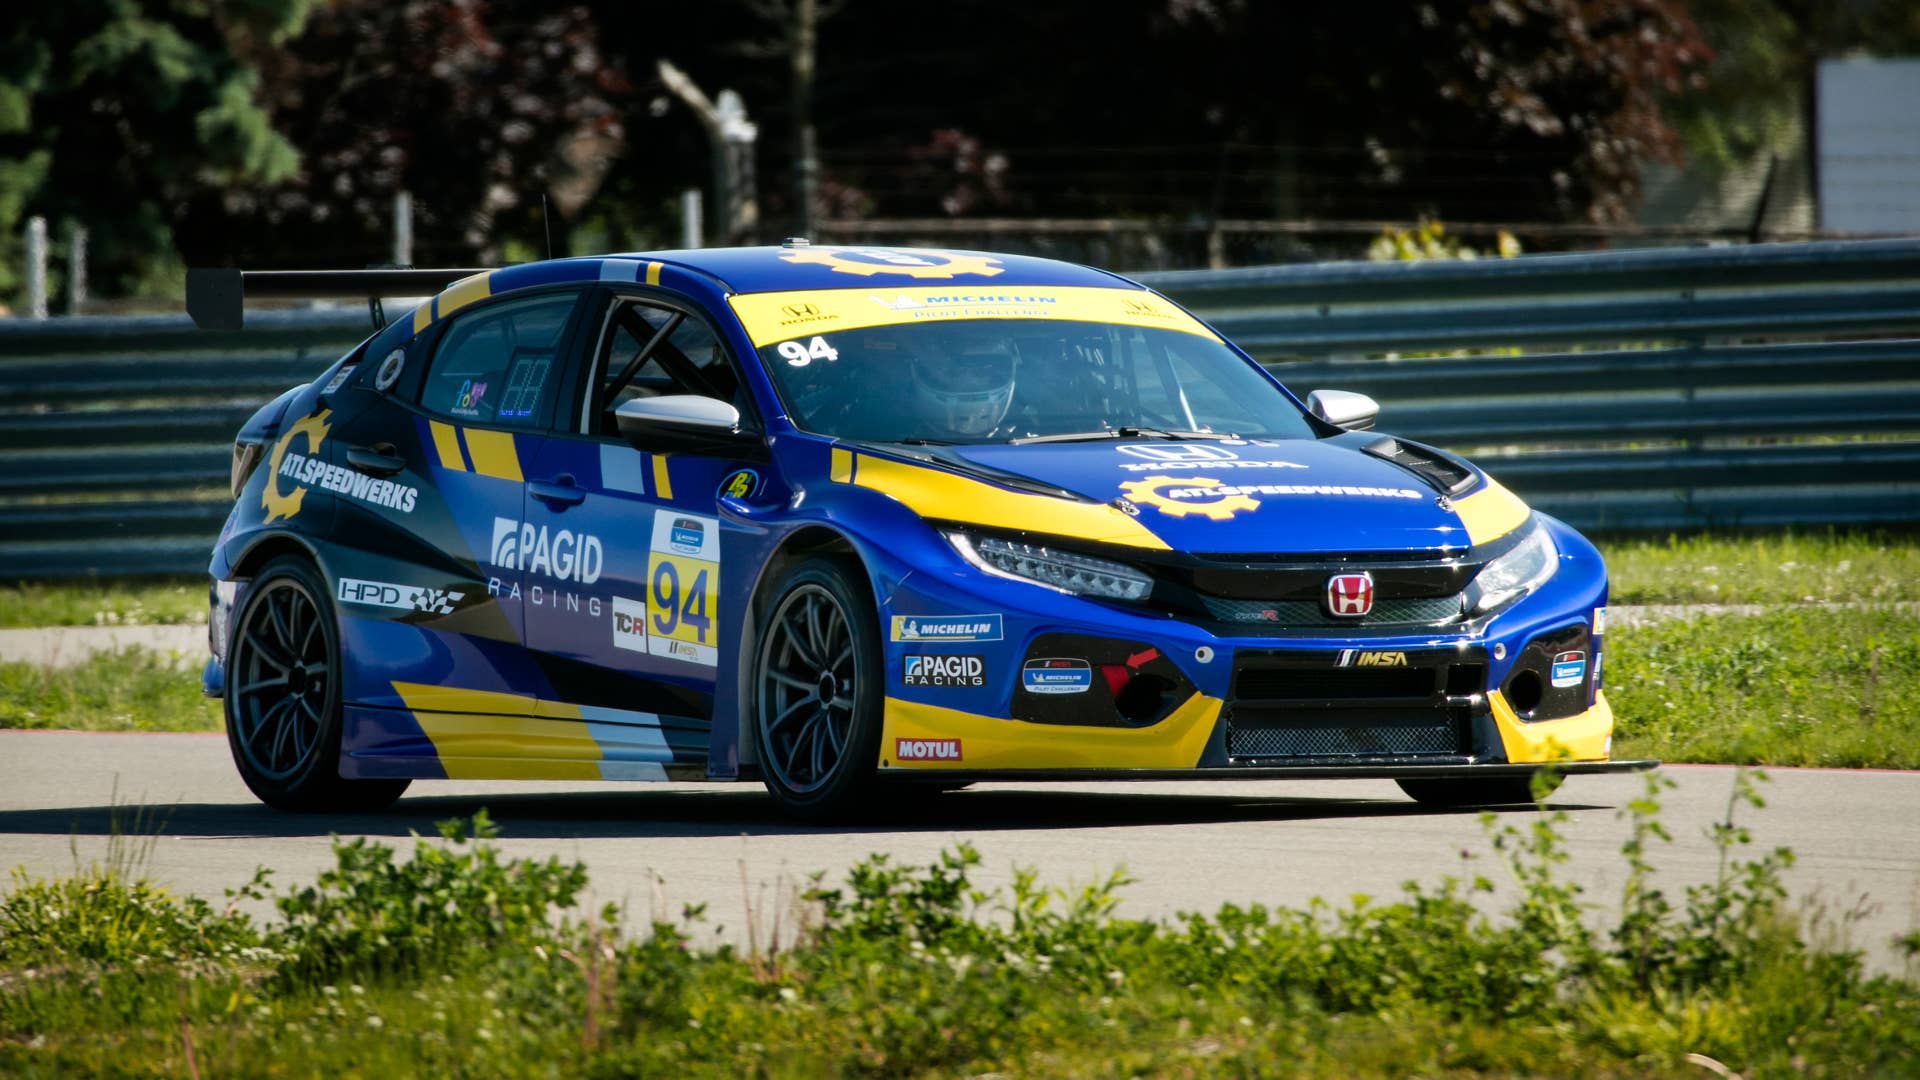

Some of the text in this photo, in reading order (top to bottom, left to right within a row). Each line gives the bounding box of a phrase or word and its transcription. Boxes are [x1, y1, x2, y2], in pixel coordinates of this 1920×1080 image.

[926, 295, 1056, 303] MICHELIN
[779, 315, 839, 326] HONDA
[777, 335, 839, 367] 94
[1118, 460, 1310, 471] HONDA
[278, 452, 418, 513] ATLSPEEDWERKS
[1168, 485, 1423, 499] ATLSPEEDWERKS
[517, 521, 603, 585] PAGID
[340, 581, 401, 604] HPD
[488, 576, 601, 617] RACING
[652, 560, 711, 643] 94
[614, 611, 644, 636] TCR
[920, 623, 991, 634] MICHELIN
[923, 655, 983, 677] PAGID
[1357, 651, 1408, 666] IMSA
[904, 675, 983, 686] RACING
[899, 740, 959, 758] MOTUL
